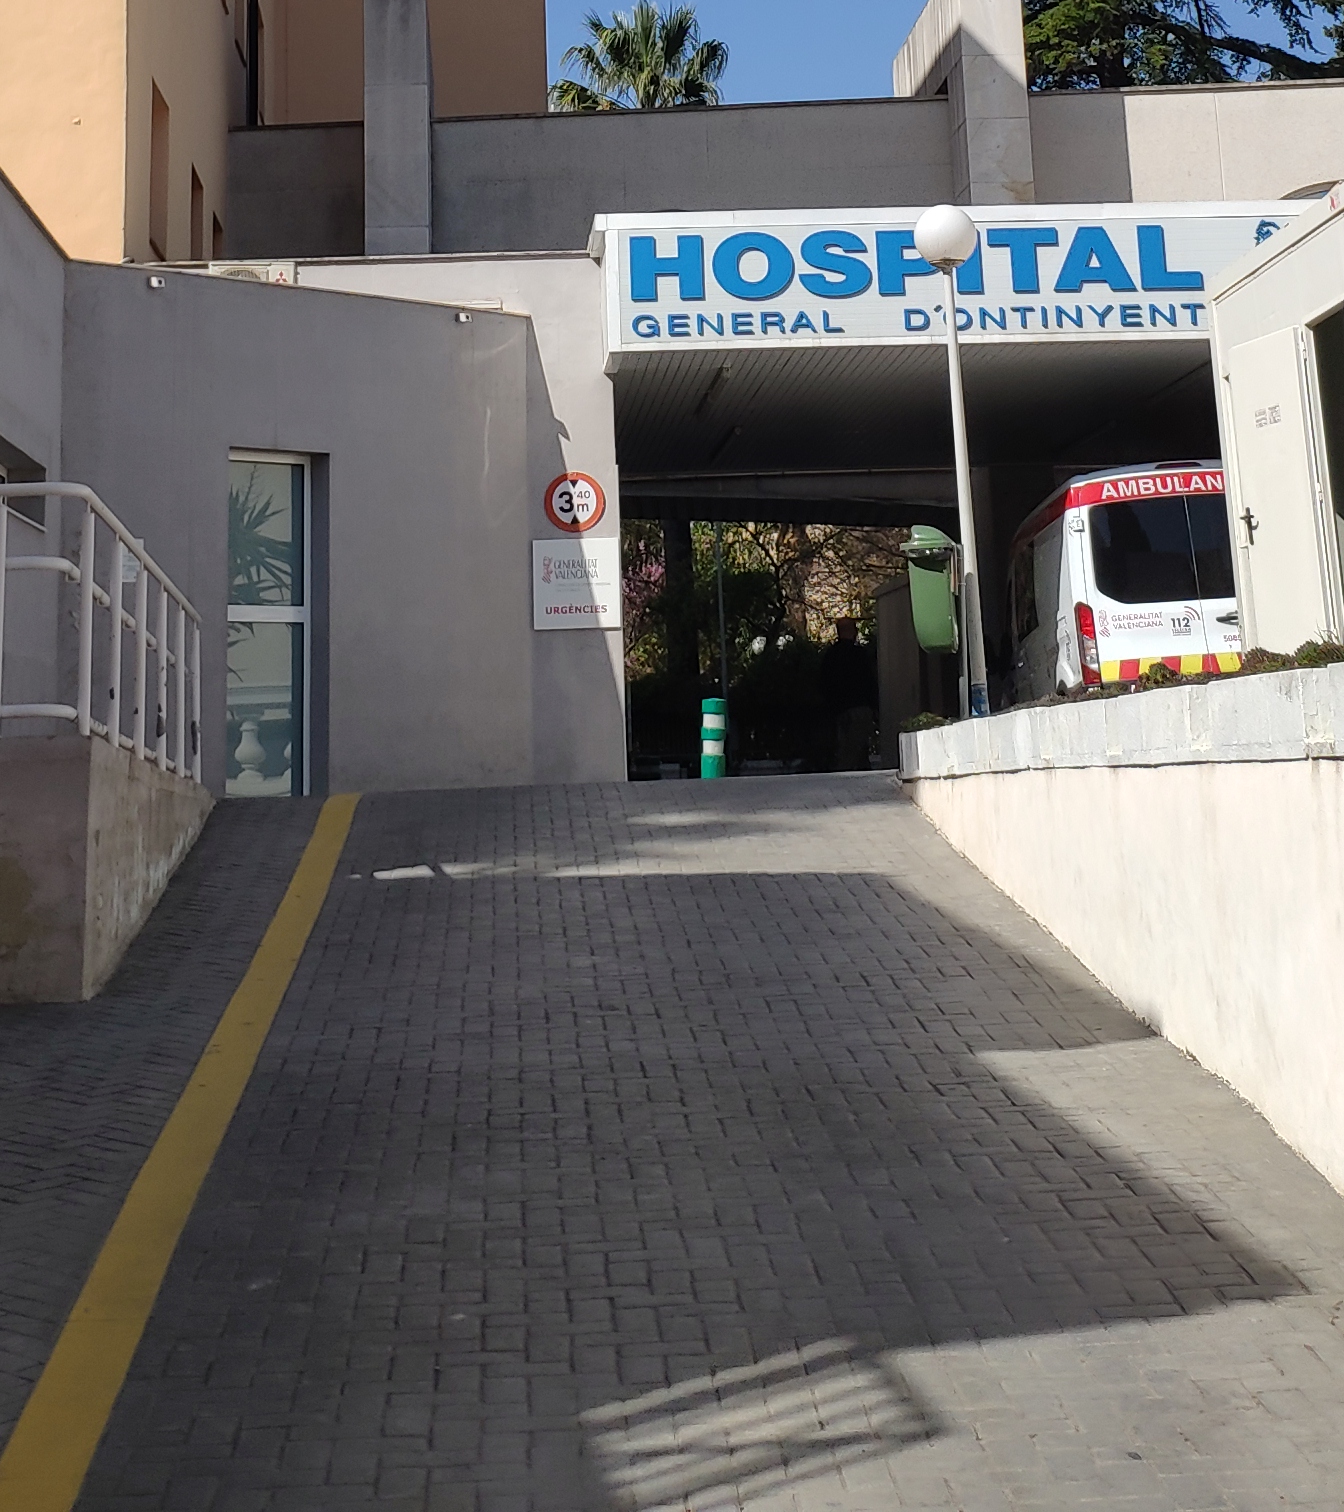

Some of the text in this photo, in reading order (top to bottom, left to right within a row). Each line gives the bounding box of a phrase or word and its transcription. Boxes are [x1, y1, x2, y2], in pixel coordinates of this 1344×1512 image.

[629, 225, 1205, 301] HOSPITAL
[632, 310, 844, 337] GENERAL
[576, 501, 589, 513] m
[554, 558, 598, 569] GENERALITAT
[554, 569, 599, 579] VALENCIANA
[545, 603, 608, 615] URGÈNCIES
[1111, 611, 1163, 622] GENERALITAT
[1112, 620, 1164, 630] VALENCIANA
[1171, 617, 1191, 628] 112
